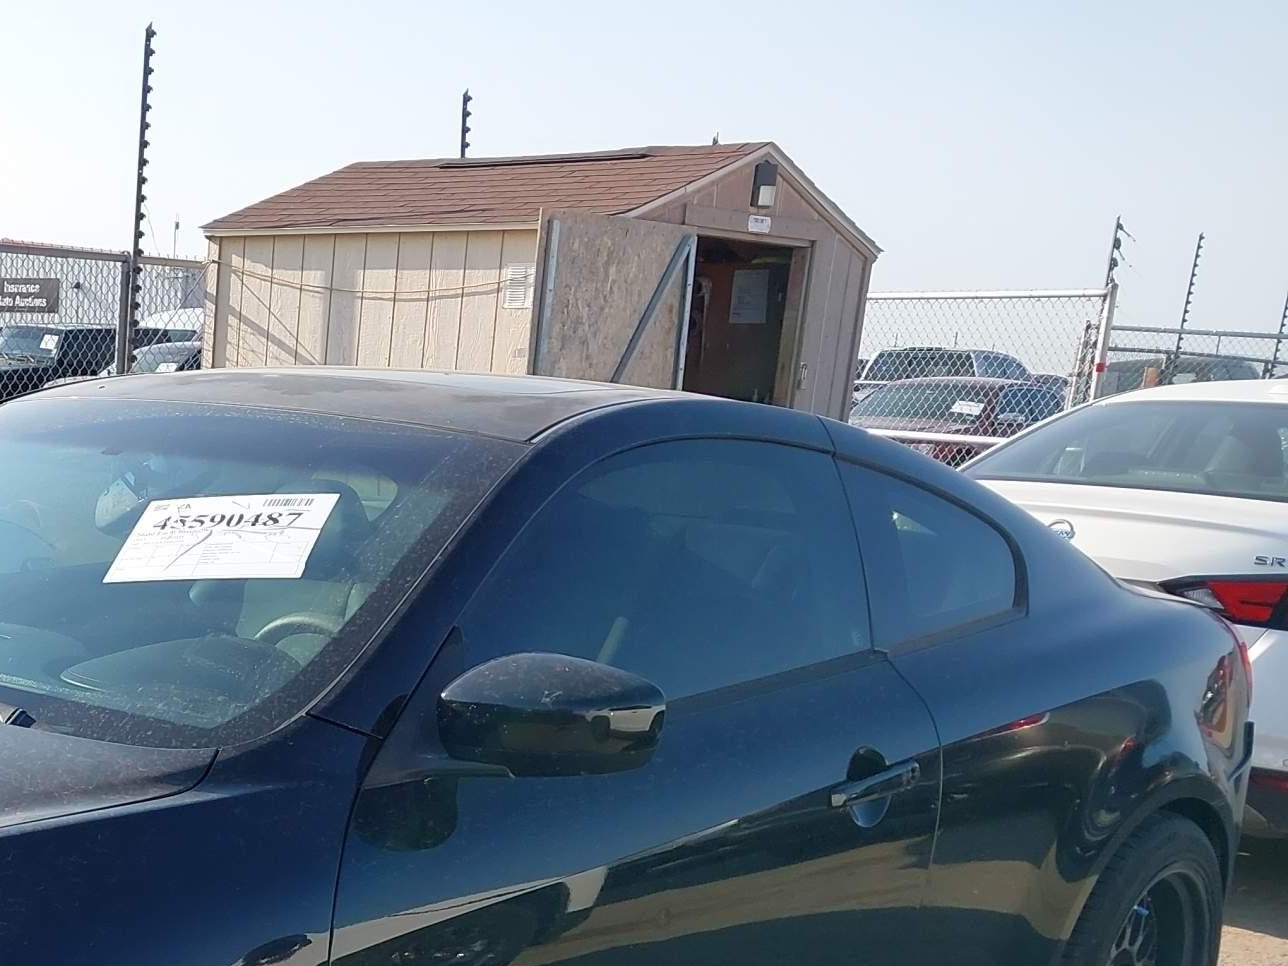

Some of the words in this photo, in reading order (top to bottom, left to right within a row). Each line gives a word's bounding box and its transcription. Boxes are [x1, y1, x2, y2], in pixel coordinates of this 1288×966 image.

[4, 281, 40, 293] Insurance
[15, 295, 47, 307] Auctions
[152, 511, 304, 531] 45590487
[1253, 555, 1287, 568] SR
